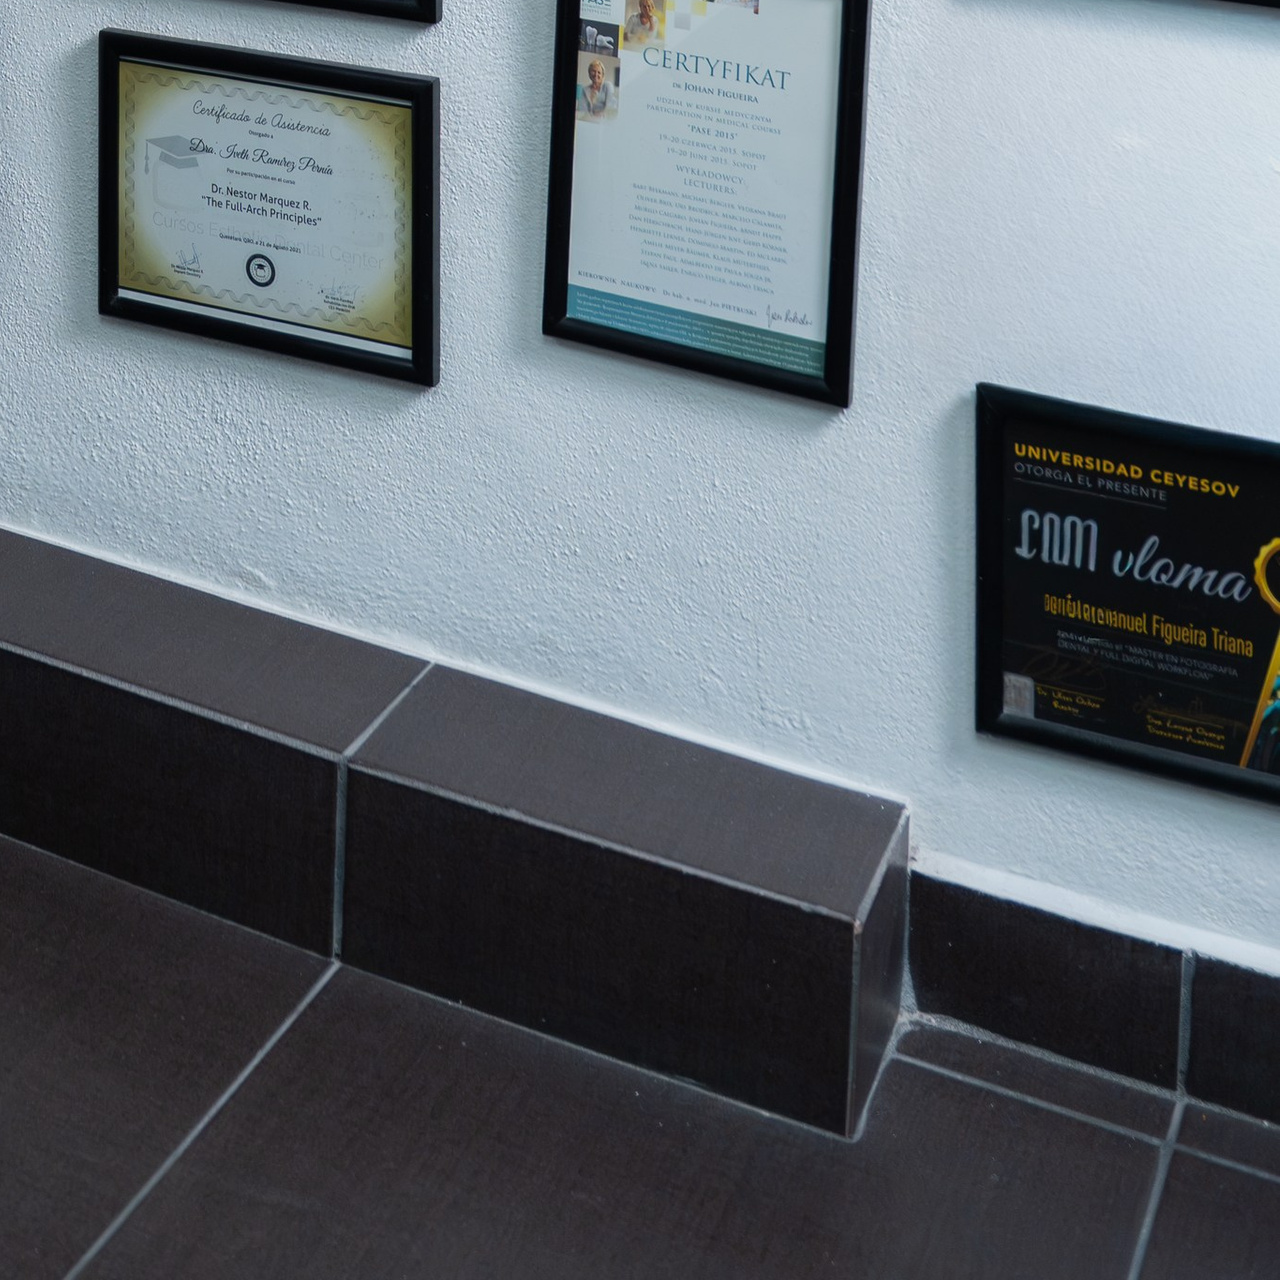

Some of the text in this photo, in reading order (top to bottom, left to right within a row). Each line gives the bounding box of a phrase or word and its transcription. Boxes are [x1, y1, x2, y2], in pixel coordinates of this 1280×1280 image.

[643, 47, 791, 90] CERTYFIKAT
[684, 82, 759, 104] JOHAN FIGUEIRA
[211, 184, 312, 211] Dr. Nestor Marquez R.
[226, 200, 267, 217] Full-Arch
[1015, 442, 1240, 498] UNIVERSIDAD CEYESOV
[1152, 614, 1254, 657] Figueira Triana
